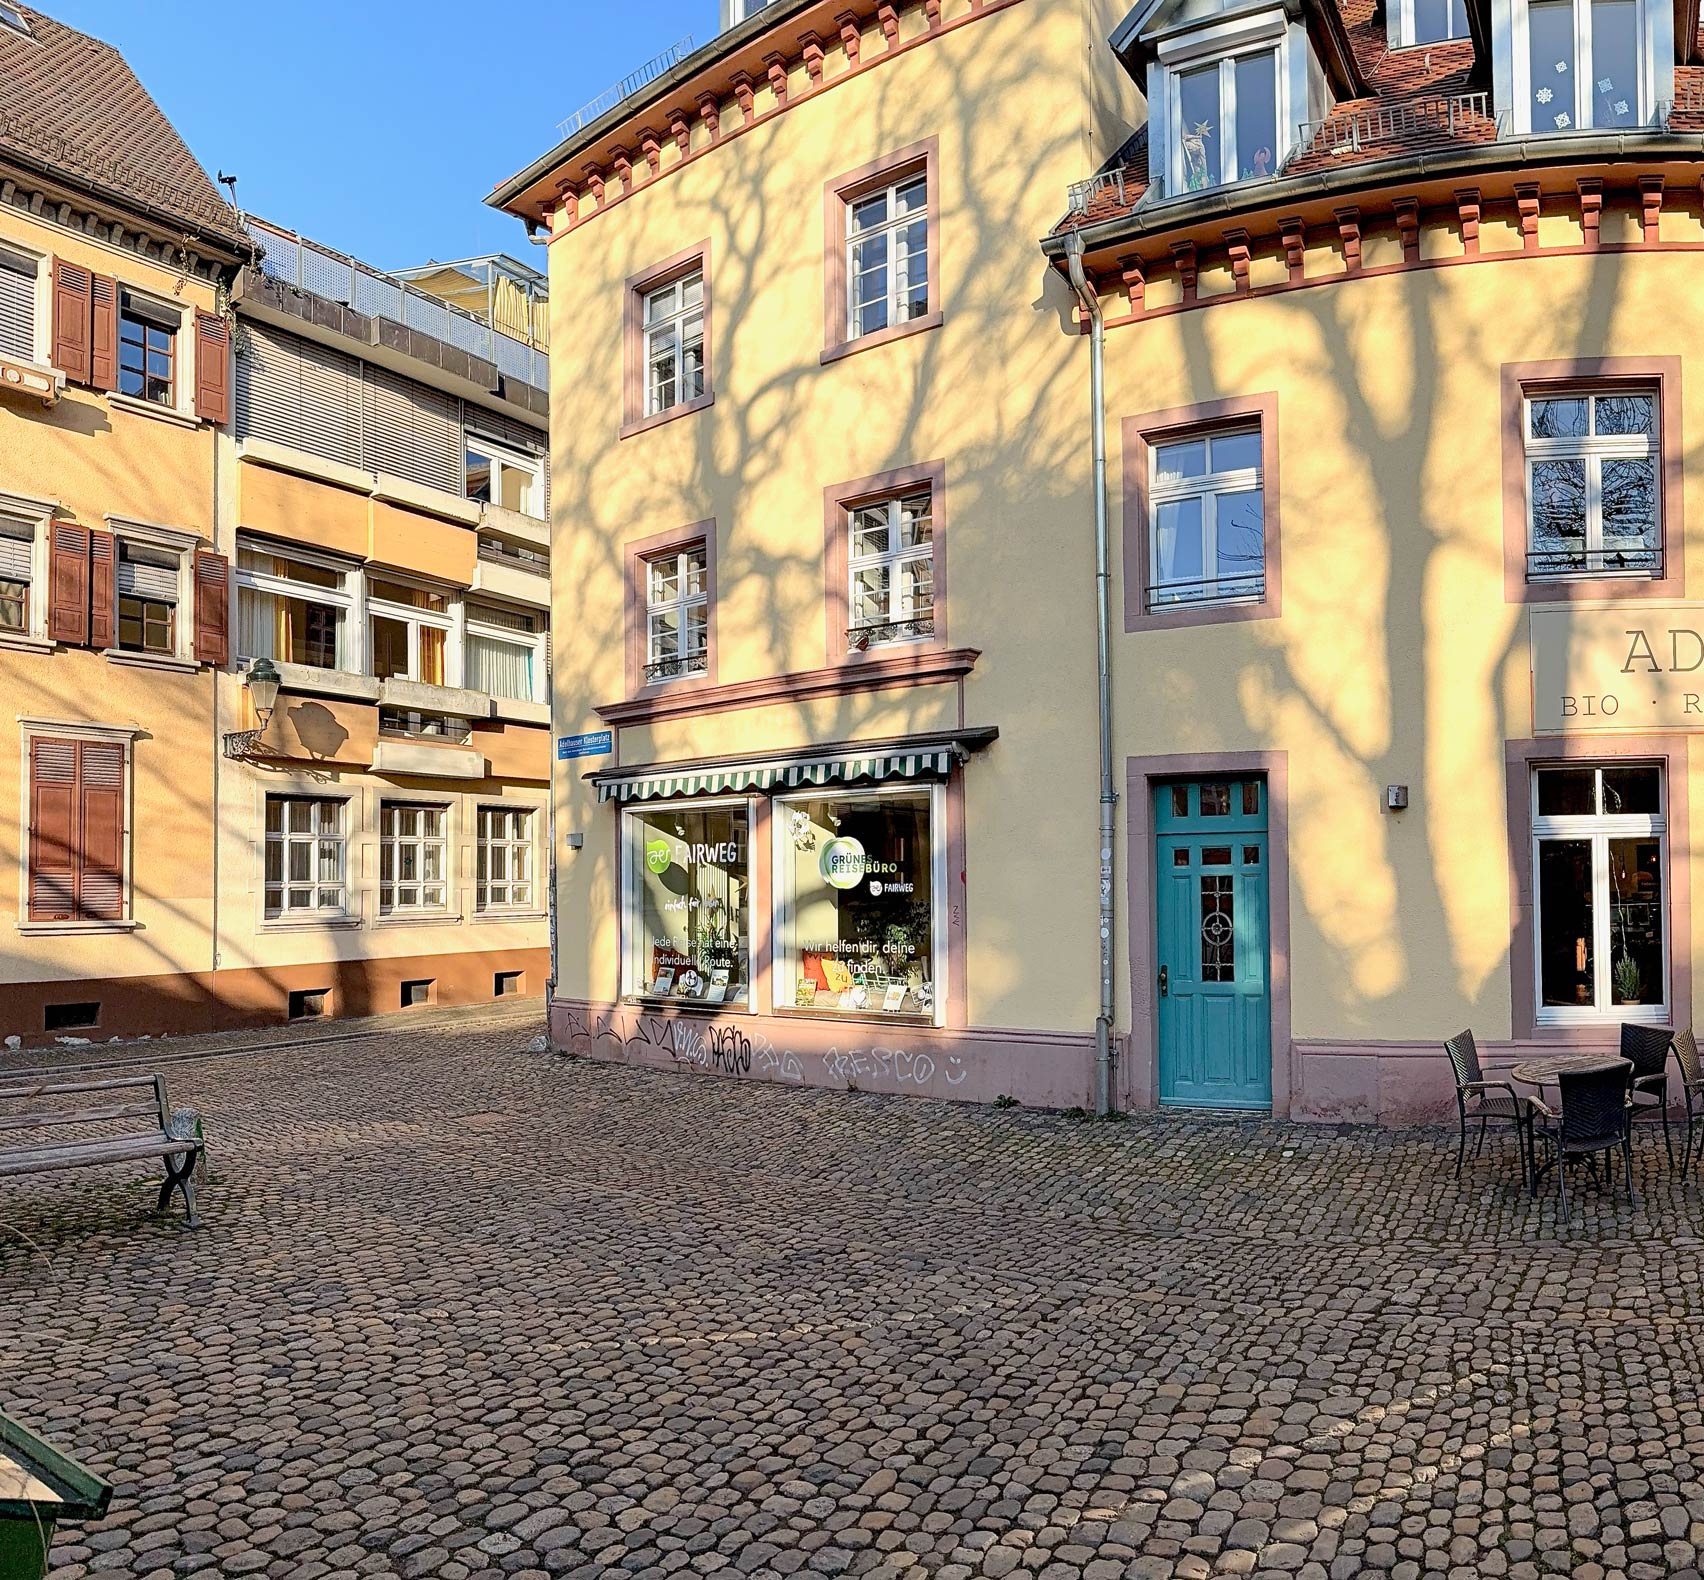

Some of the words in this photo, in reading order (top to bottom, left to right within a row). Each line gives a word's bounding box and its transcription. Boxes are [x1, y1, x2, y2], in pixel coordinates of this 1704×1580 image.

[1560, 695, 1619, 717] BIO
[675, 842, 737, 864] FAIRWEG
[831, 852, 873, 864] GRÜNES
[831, 862, 898, 874] REISEBÜRO
[884, 882, 914, 893] FAIRWEG
[825, 938, 861, 954] helfen
[882, 939, 916, 954] deine
